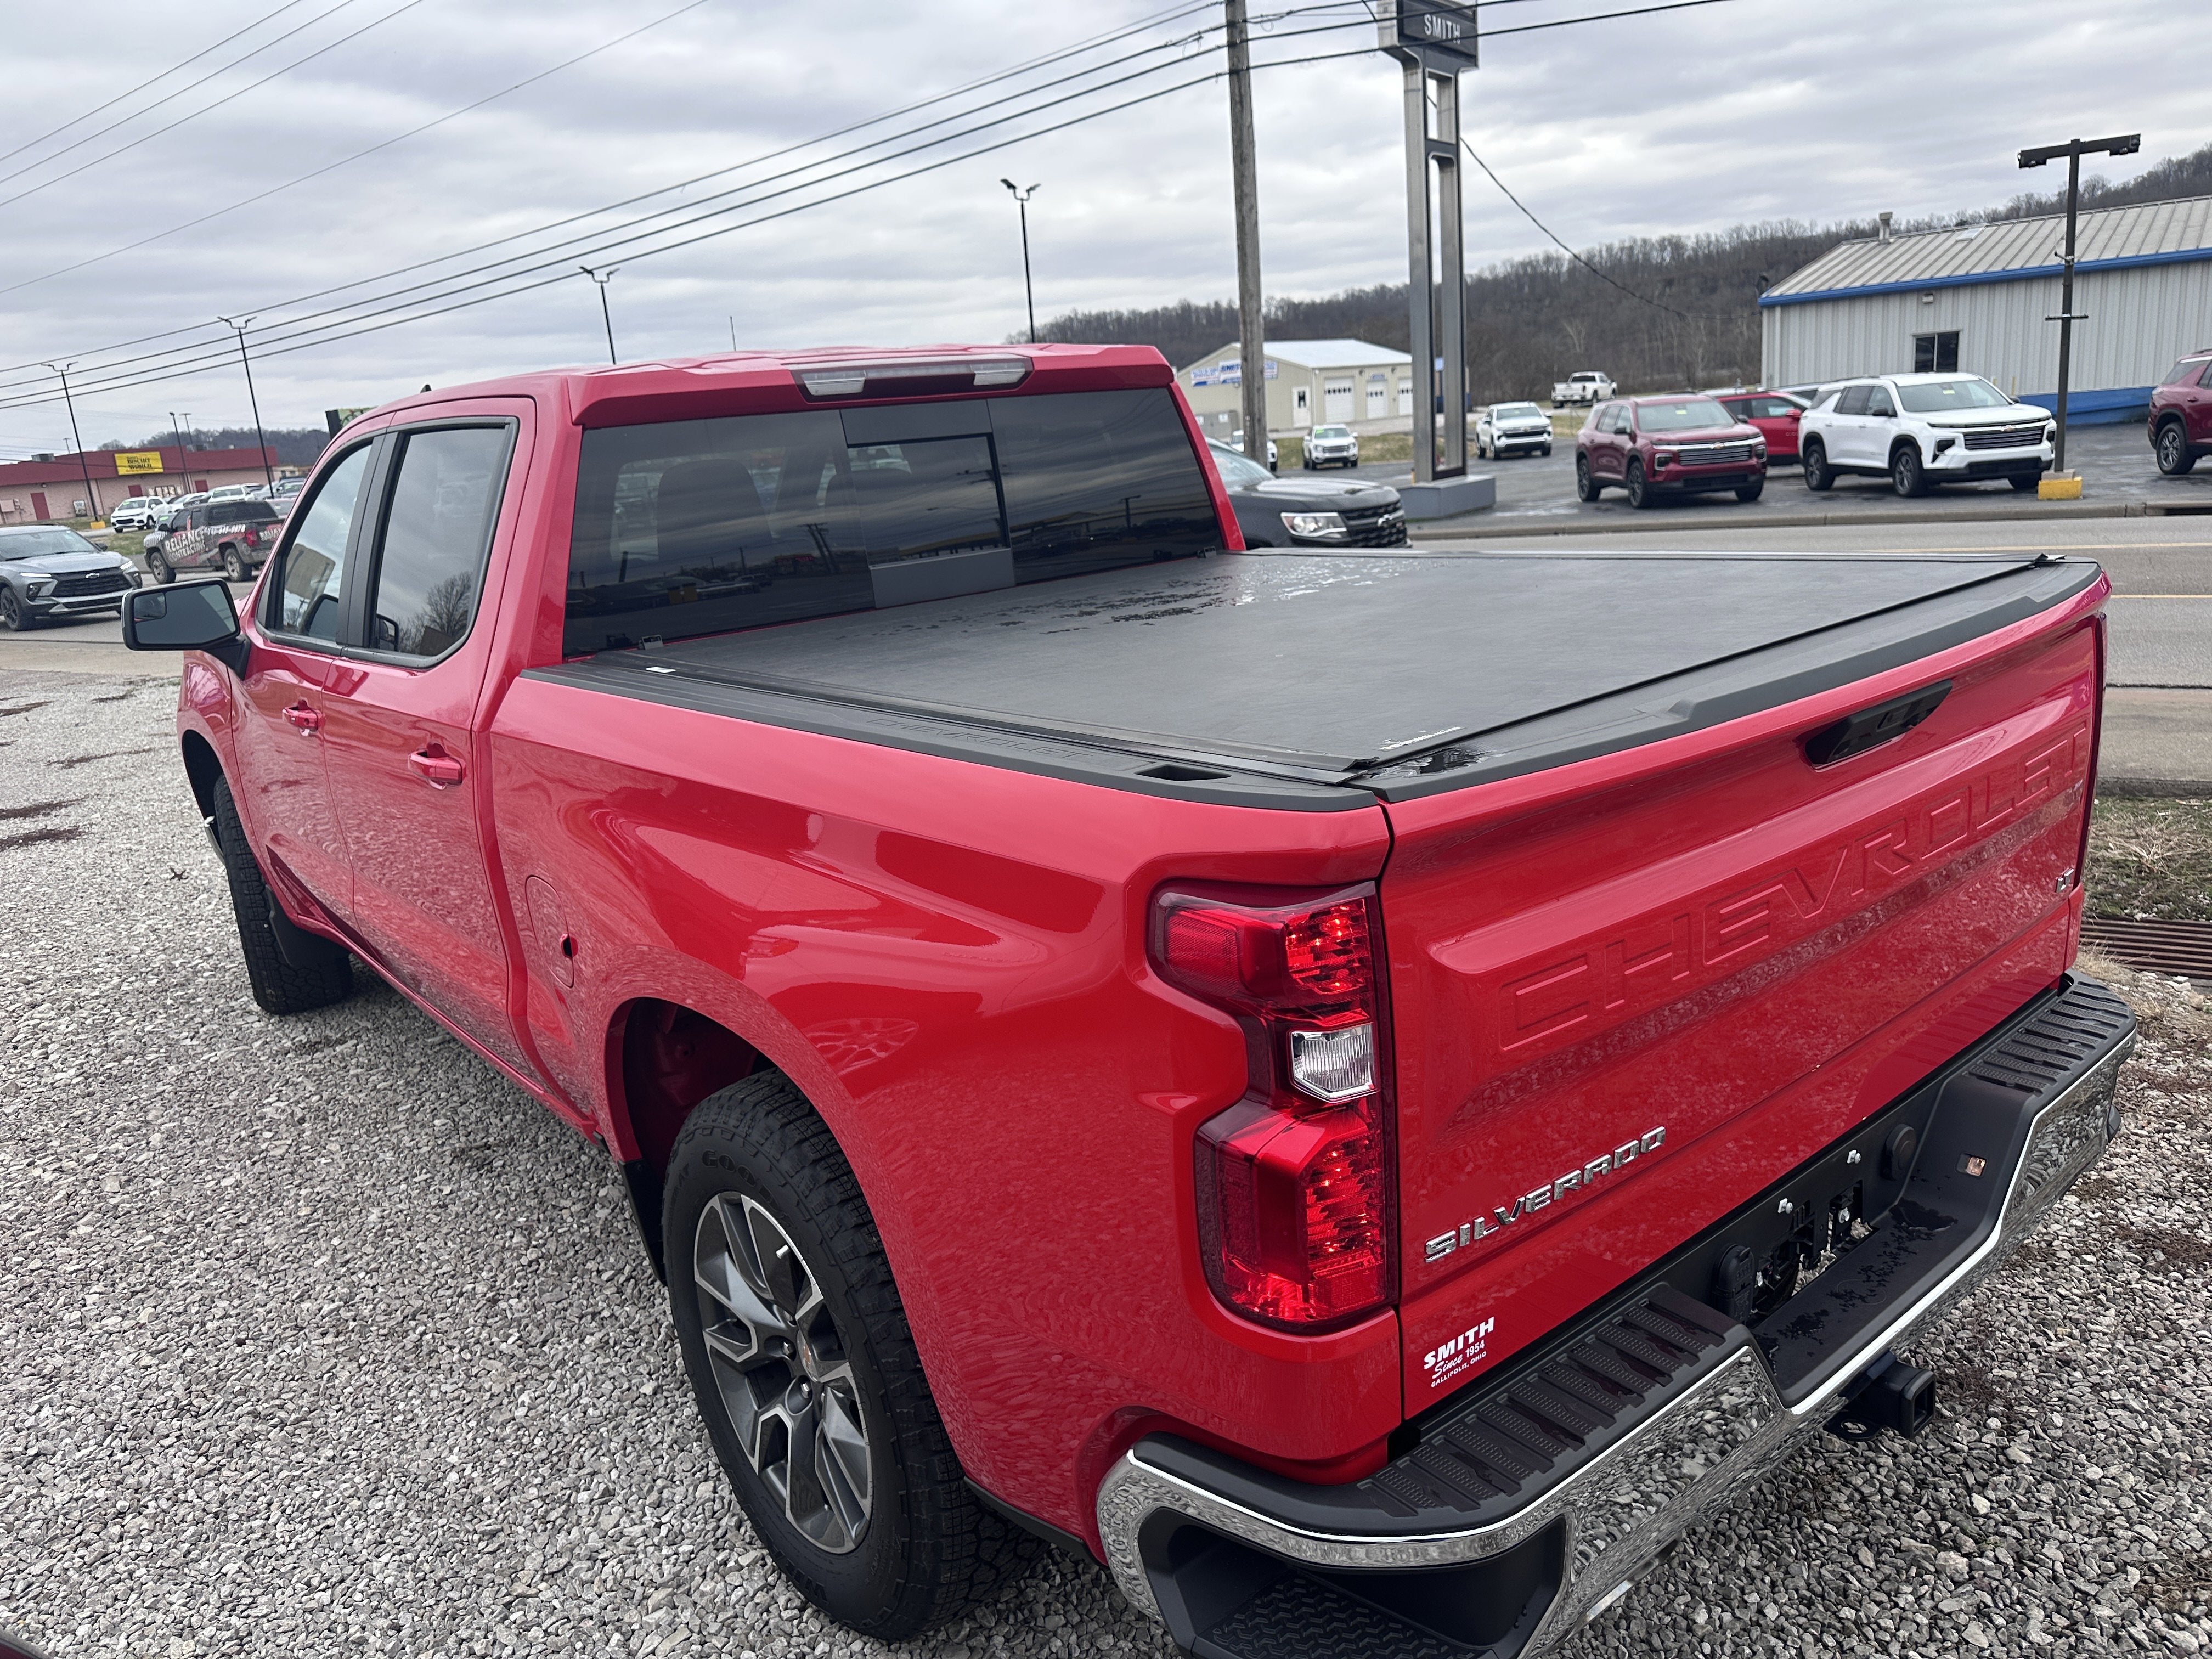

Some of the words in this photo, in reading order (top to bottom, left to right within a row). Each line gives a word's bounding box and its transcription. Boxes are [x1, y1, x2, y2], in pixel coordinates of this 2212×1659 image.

[1424, 14, 1460, 40] SMITH
[165, 526, 207, 554] RELIANCE
[169, 539, 206, 562] CONTRACTING
[1499, 718, 2087, 1051] CHEVROLET
[1425, 1125, 1666, 1263] SILVERADO
[1424, 1316, 1494, 1370] SMITH
[1432, 1353, 1463, 1379] Since
[1465, 1339, 1485, 1358] 1954
[1470, 1351, 1487, 1365] OHIO
